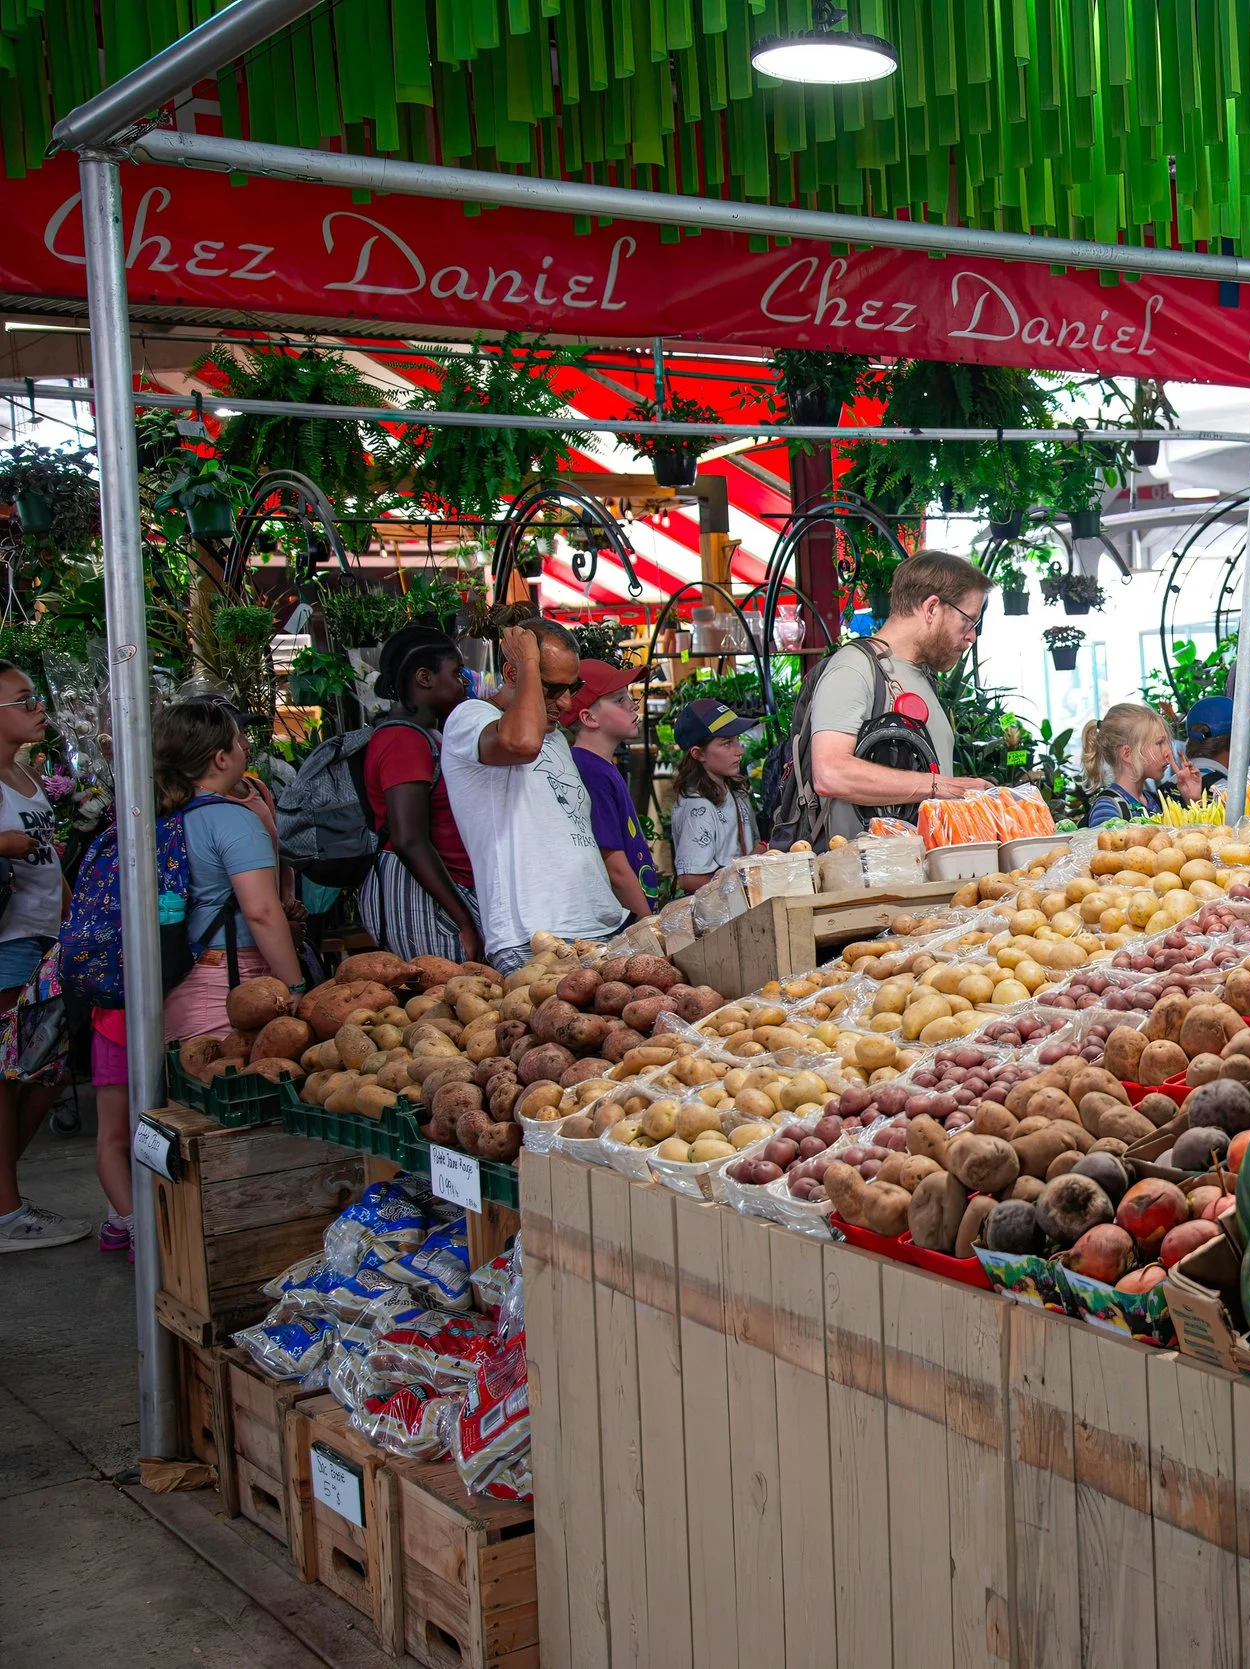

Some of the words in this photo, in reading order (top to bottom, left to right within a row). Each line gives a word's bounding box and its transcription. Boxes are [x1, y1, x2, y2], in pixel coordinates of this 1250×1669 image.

[44, 186, 276, 281] Chez
[321, 211, 637, 311] Daniel
[760, 256, 917, 334] Chez
[947, 271, 1164, 357] Daniel
